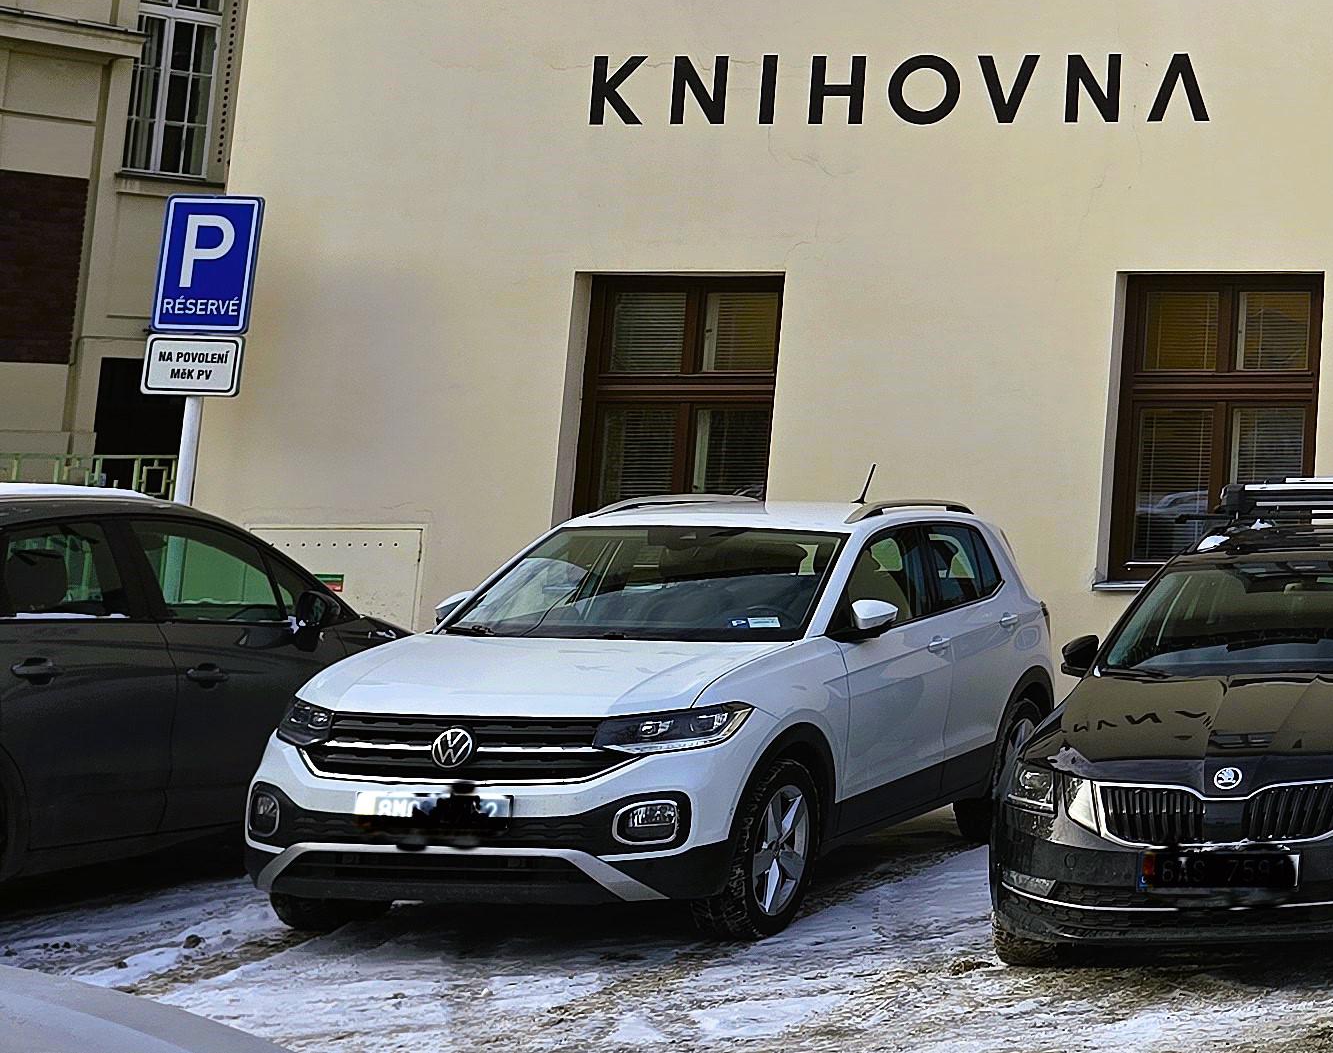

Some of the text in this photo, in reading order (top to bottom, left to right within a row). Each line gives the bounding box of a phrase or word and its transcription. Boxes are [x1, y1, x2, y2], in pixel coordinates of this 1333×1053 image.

[588, 53, 1210, 126] KNIHOVNA
[179, 214, 235, 288] P
[162, 295, 240, 316] RÉSERVÉ
[158, 350, 230, 364] NA POVOLENÍ
[170, 368, 213, 380] MěK PV
